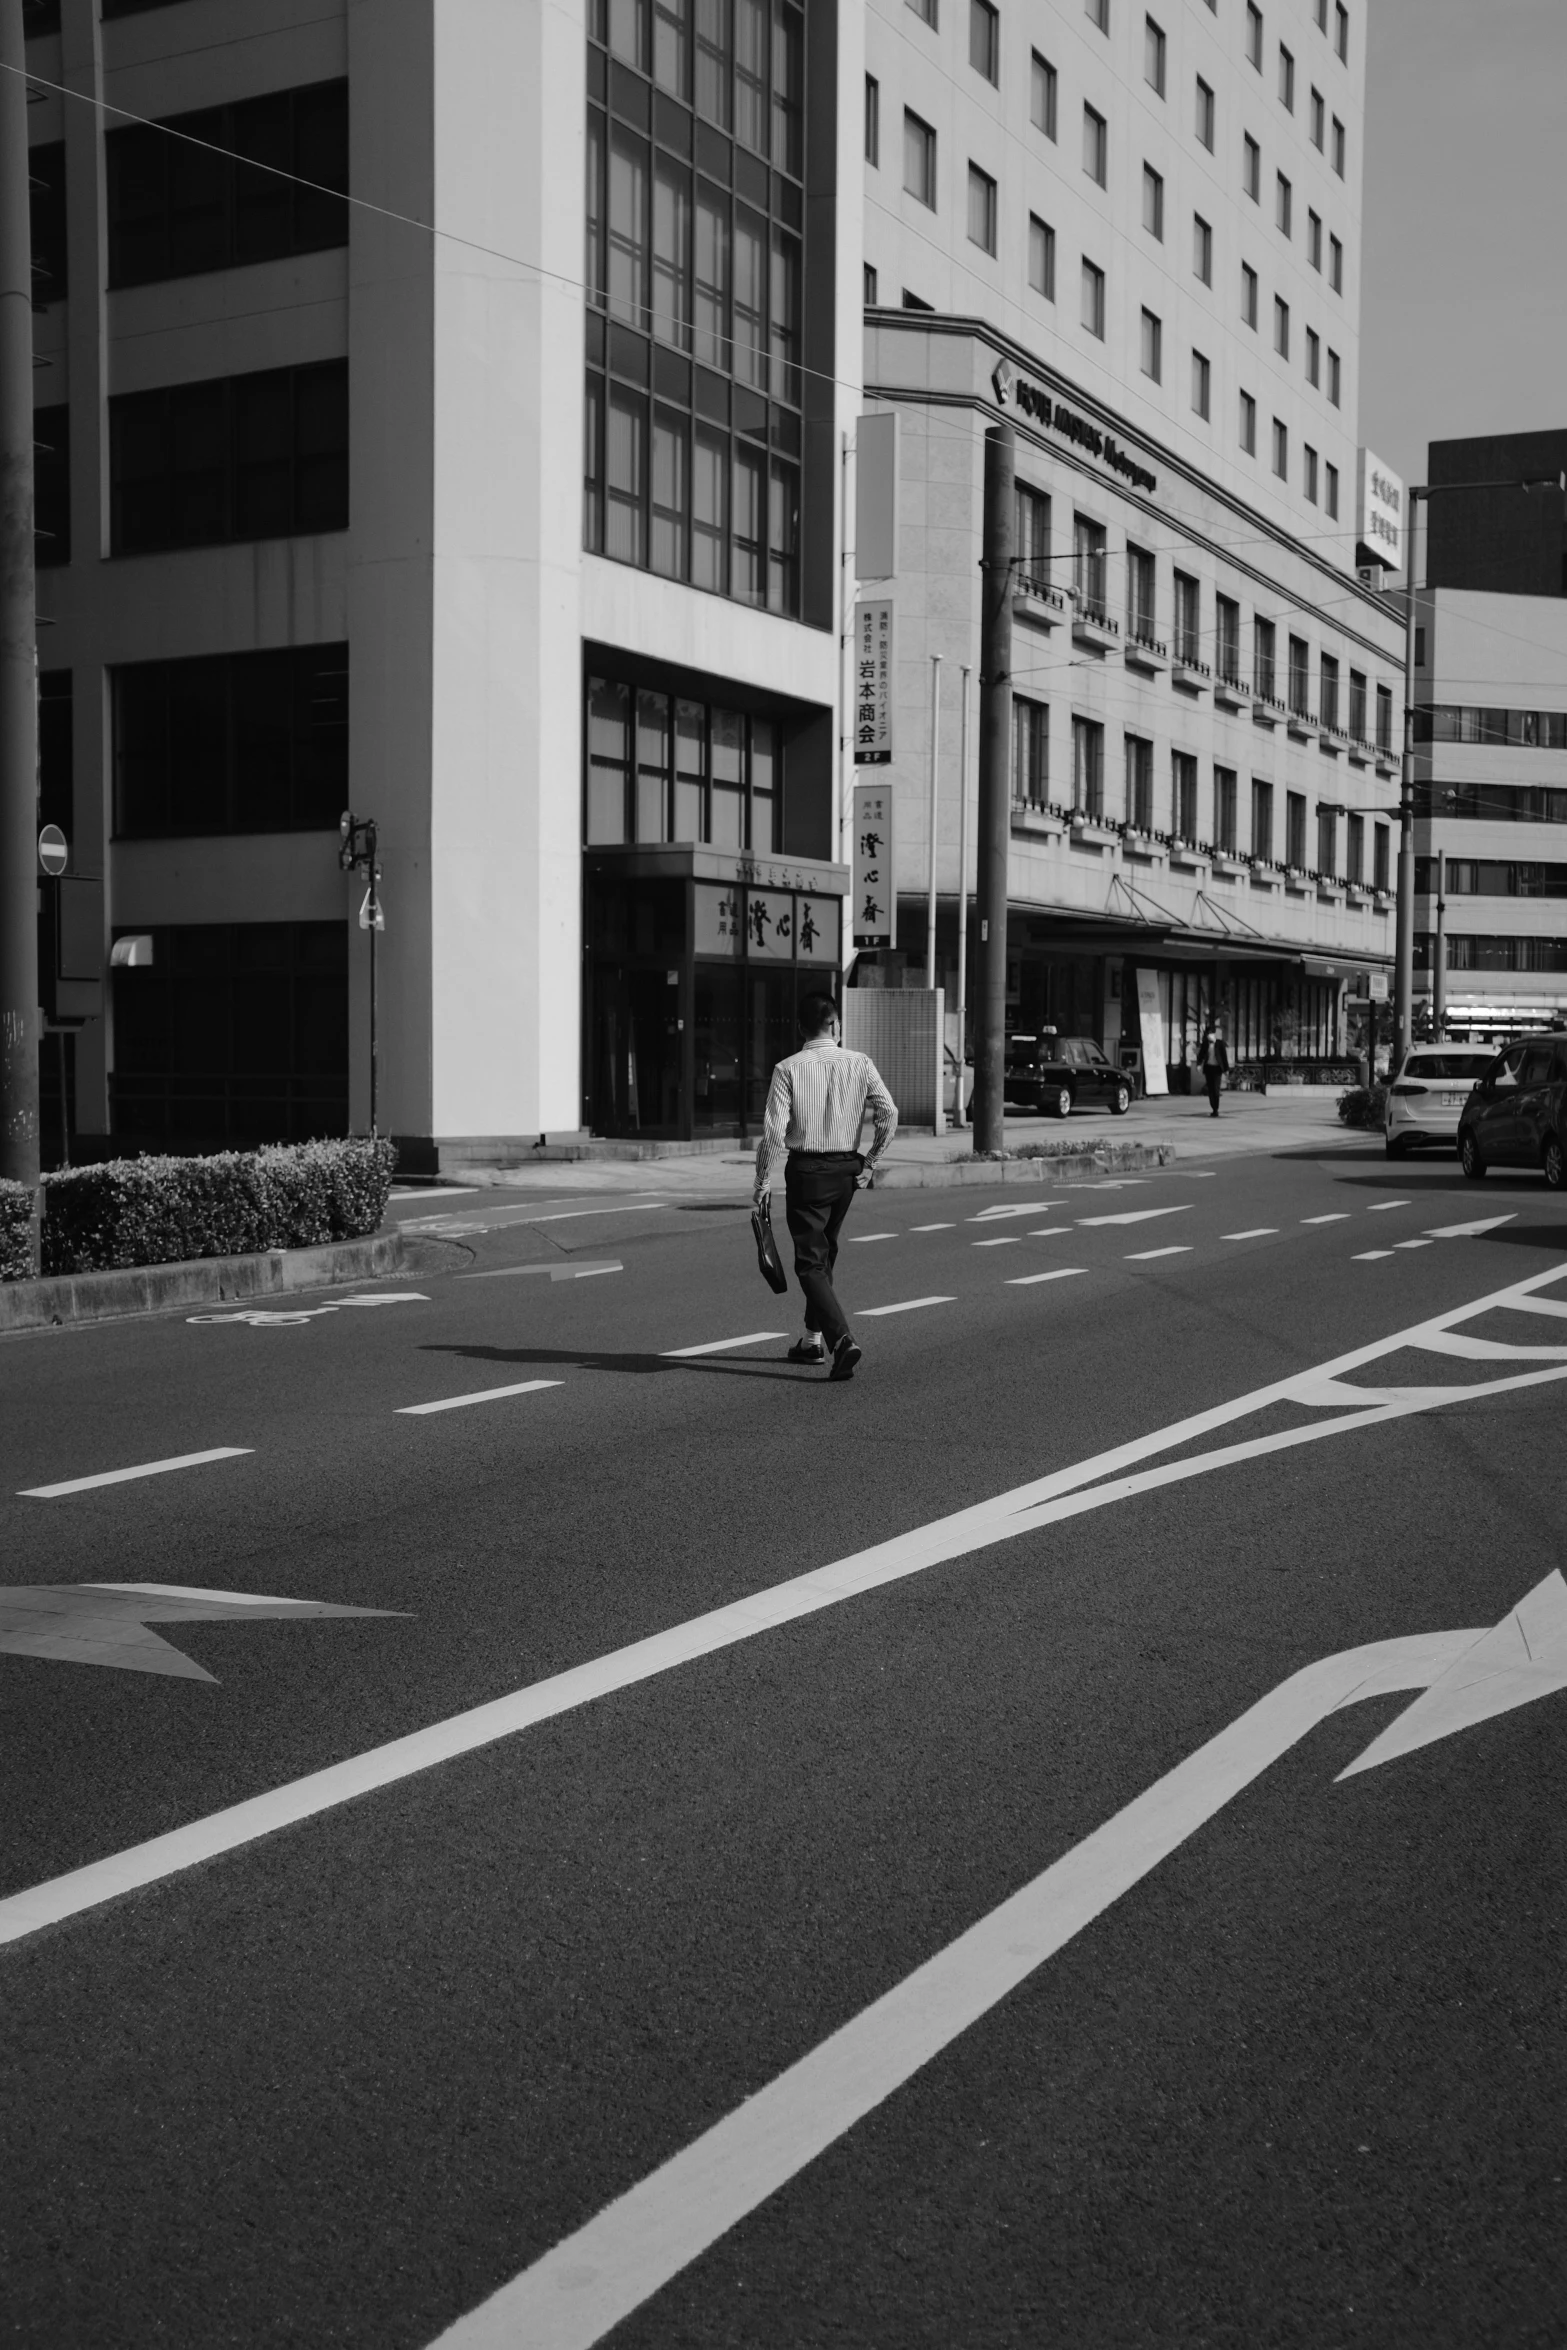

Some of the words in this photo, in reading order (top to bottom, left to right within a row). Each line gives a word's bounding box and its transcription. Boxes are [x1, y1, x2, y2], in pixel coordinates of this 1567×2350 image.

[863, 613, 872, 654] 株式会社
[859, 659, 876, 744] 岩本商会
[864, 752, 881, 762] 2F
[864, 936, 880, 946] 1F
